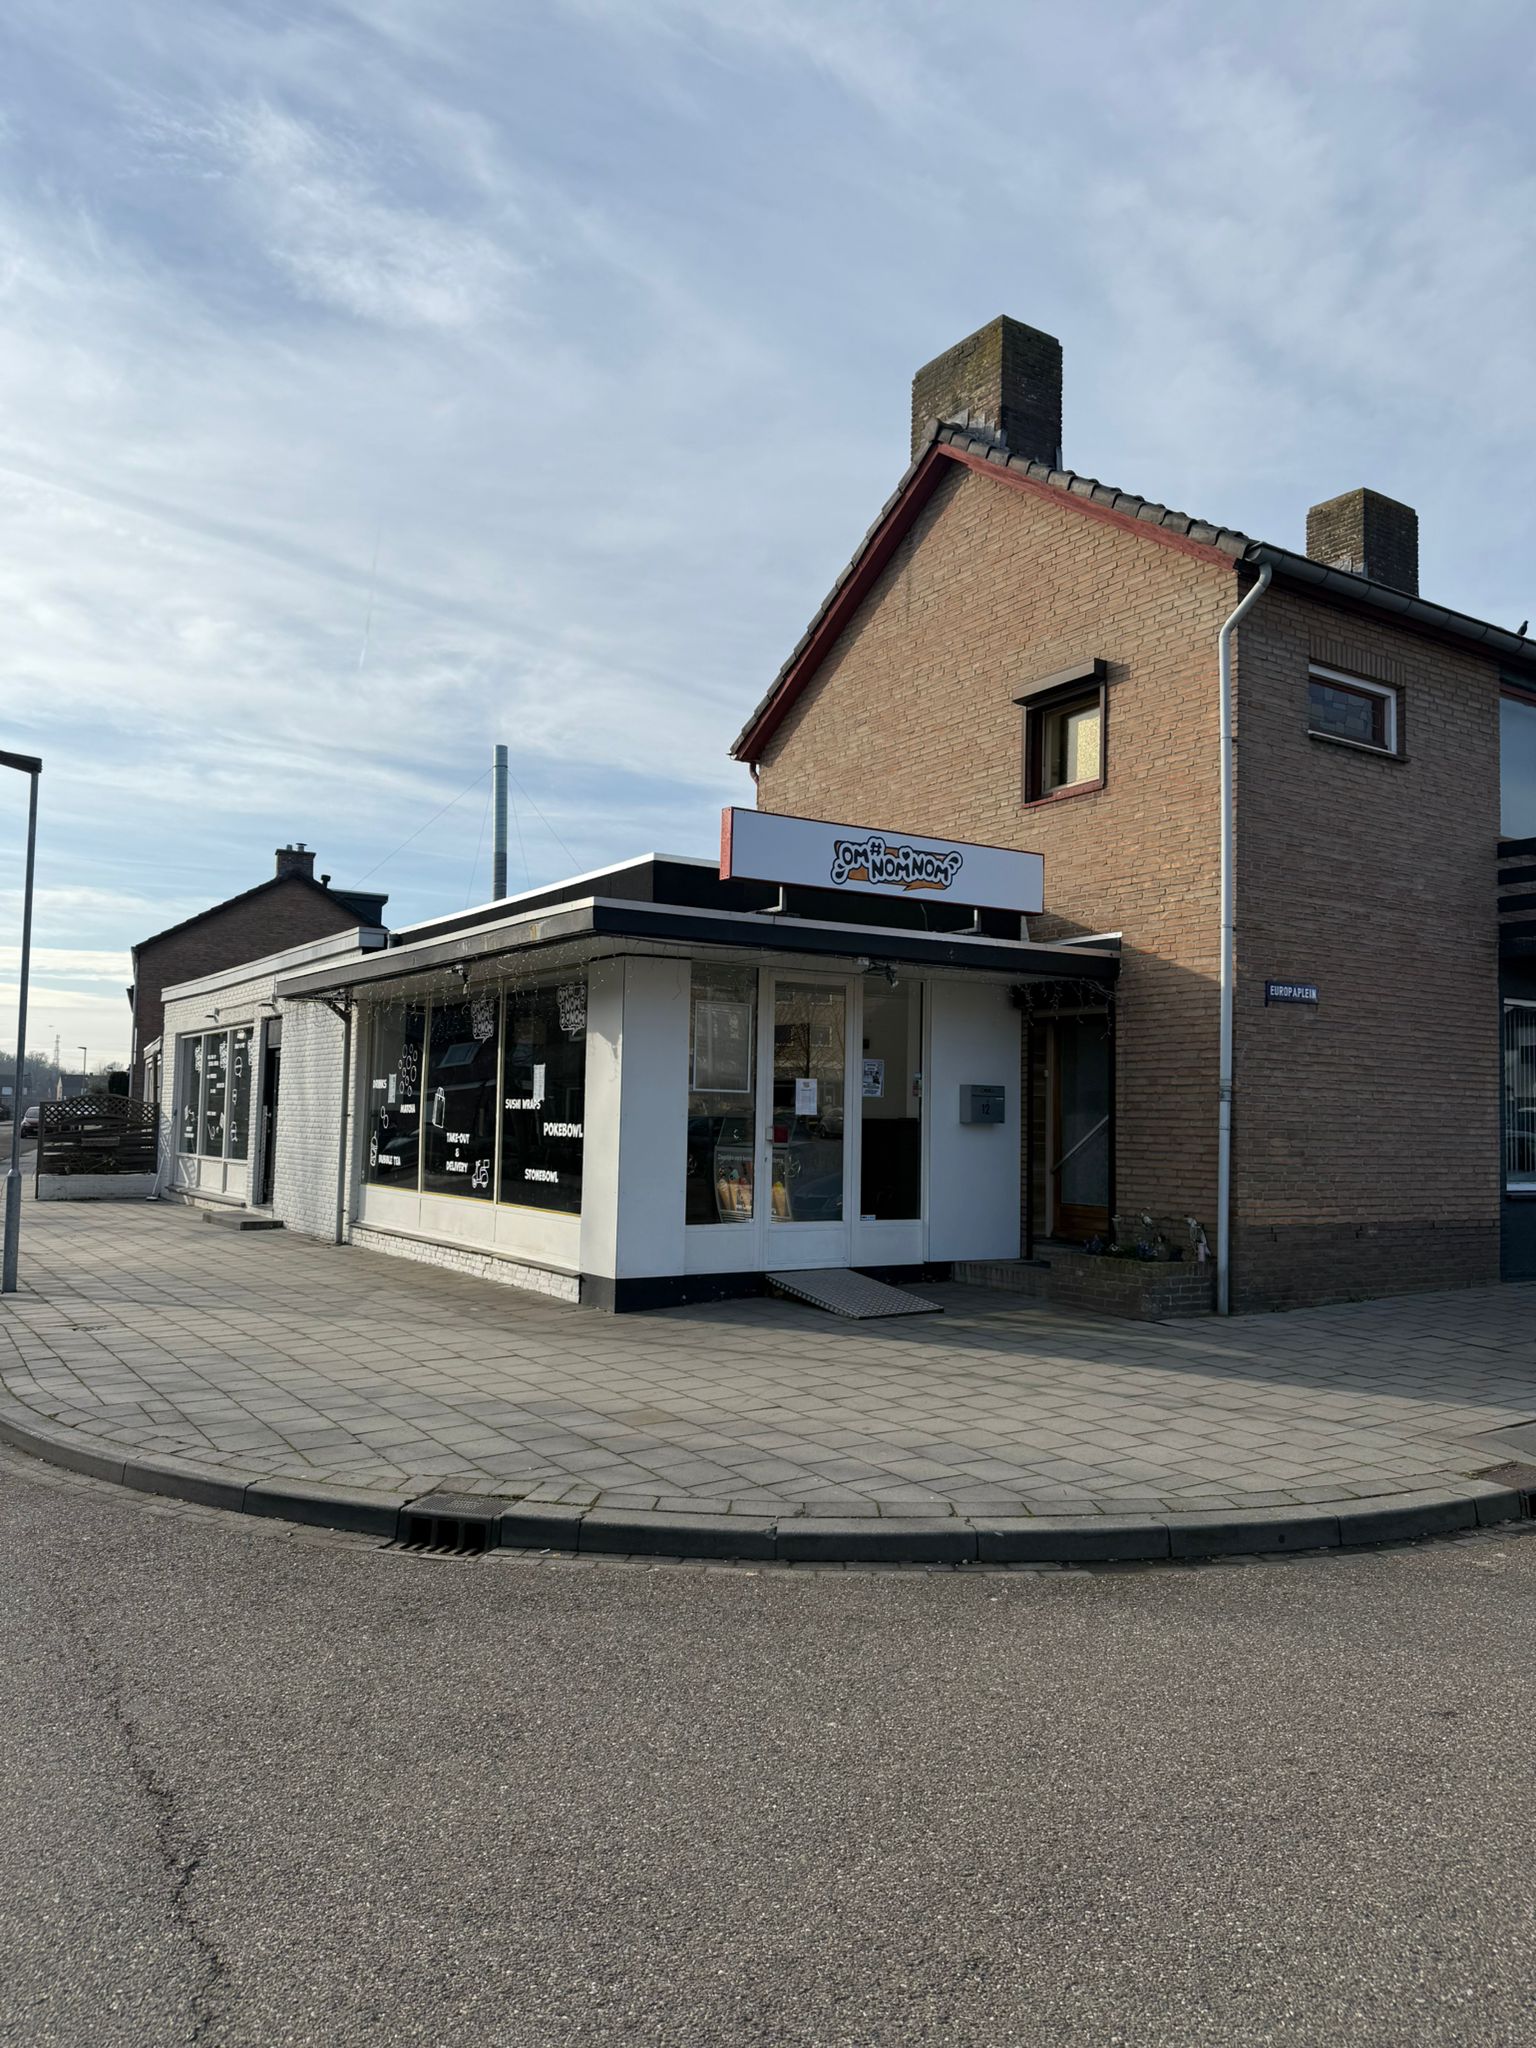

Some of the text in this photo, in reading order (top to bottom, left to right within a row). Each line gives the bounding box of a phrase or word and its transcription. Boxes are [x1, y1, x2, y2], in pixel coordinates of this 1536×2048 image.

[1270, 985, 1317, 999] EUROPAPLEIN
[372, 1079, 388, 1089] DRINKS
[400, 1104, 416, 1114] MATCHA
[505, 1098, 541, 1110] SUSHI WRAPS
[982, 1104, 991, 1115] 12
[543, 1123, 583, 1138] POKEBOWL
[446, 1132, 470, 1145] TAKE-OUT
[378, 1154, 401, 1166] BUBBLE TEA
[446, 1160, 468, 1173] DELIVERY
[525, 1169, 559, 1183] STONEBOWL
